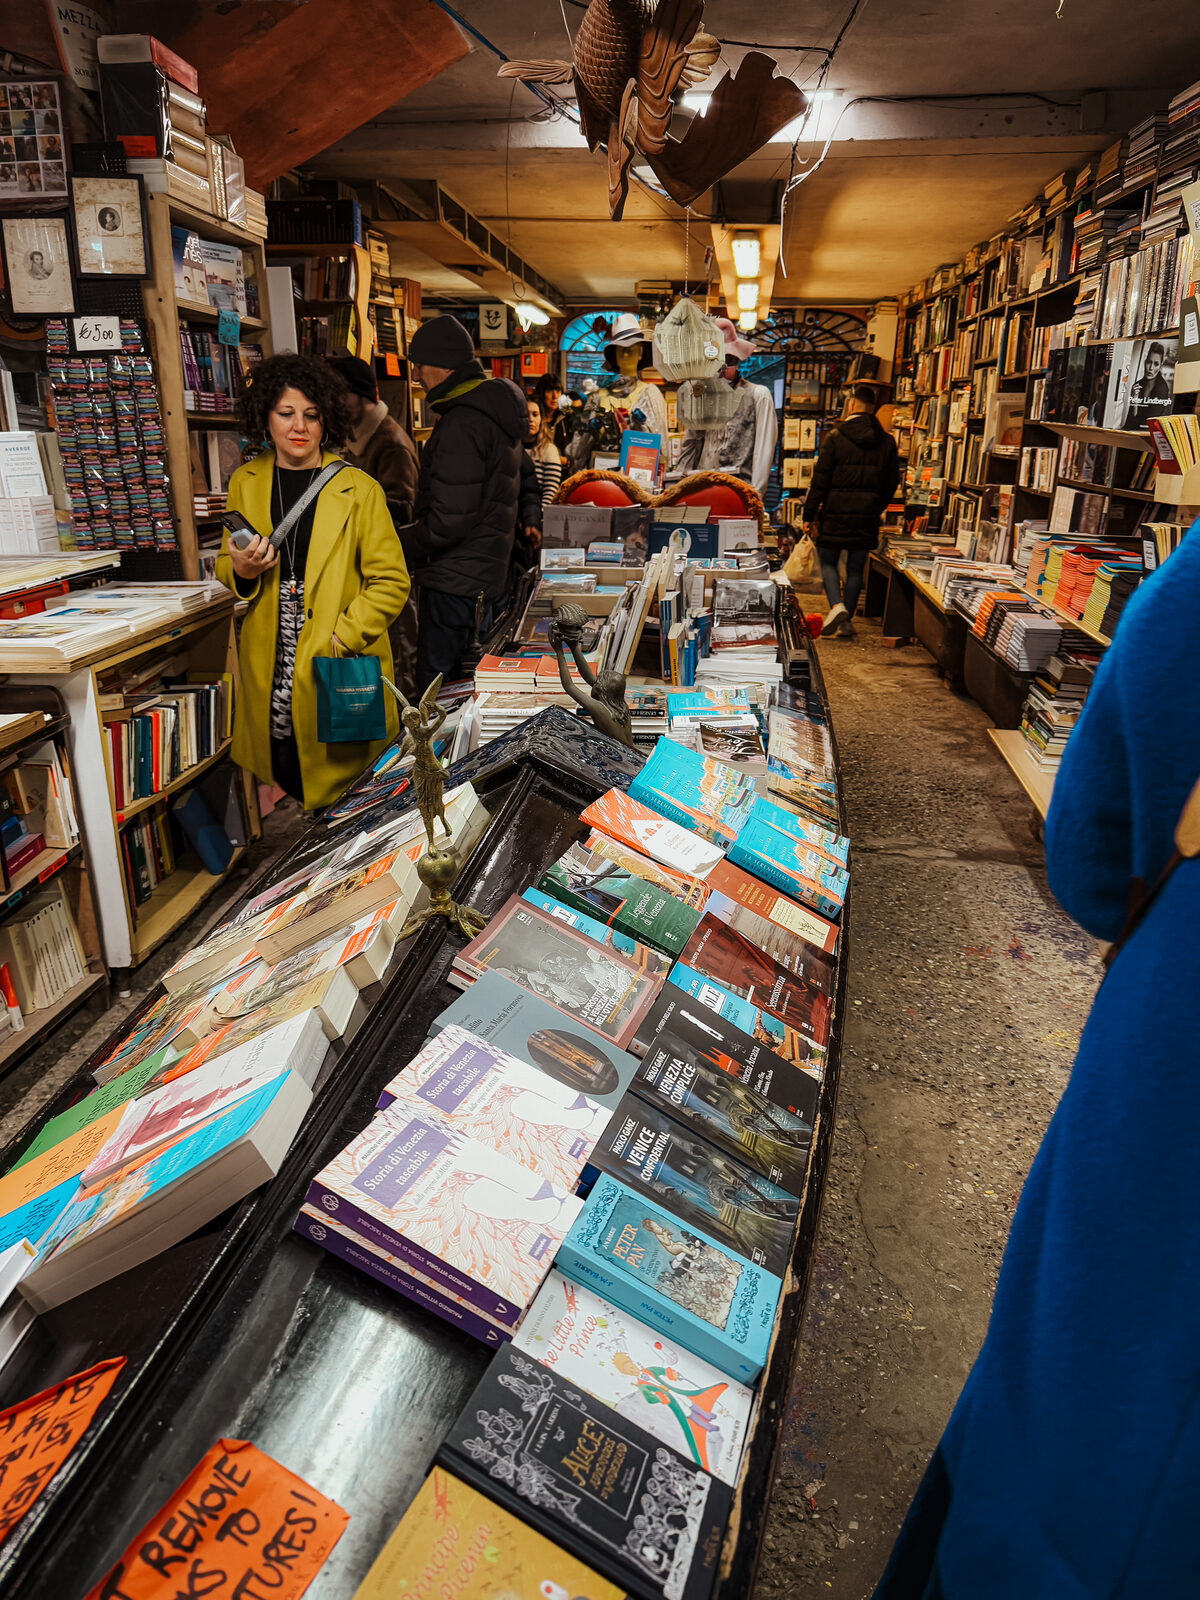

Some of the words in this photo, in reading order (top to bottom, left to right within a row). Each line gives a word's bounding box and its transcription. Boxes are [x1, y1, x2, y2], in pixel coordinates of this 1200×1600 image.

[1128, 396, 1143, 404] Peter
[1143, 396, 1172, 406] Lindbergh
[654, 797, 687, 820] SERENISSIMA
[753, 859, 791, 883] SERENISSIMA
[627, 892, 653, 919] Leggende
[644, 916, 652, 926] di
[649, 898, 667, 921] Venezia
[765, 975, 787, 1010] Serenissima
[479, 1023, 494, 1039] Santa
[490, 1010, 505, 1027] Maria
[502, 993, 525, 1015] Formosa
[580, 1007, 590, 1018] LA
[591, 996, 607, 1019] VENEZIA
[466, 1018, 483, 1033] elitto
[450, 1048, 478, 1077] Venezia
[646, 1065, 659, 1083] PAOLO
[656, 1050, 668, 1068] GANZ
[748, 1045, 761, 1068] Arcana
[446, 1069, 456, 1082] di
[452, 1066, 481, 1097] tascabile
[658, 1058, 685, 1096] VENEZIA
[670, 1062, 697, 1105] COMPLICE
[426, 1076, 450, 1100] Storia
[612, 1136, 625, 1155] PAOLO
[623, 1118, 636, 1138] GANZ
[627, 1126, 656, 1167] VENICE
[363, 1164, 390, 1191] Storia
[389, 1152, 402, 1167] di
[397, 1127, 429, 1158] Venezia
[395, 1148, 431, 1187] tascabile
[640, 1131, 671, 1181] CONFIDENTIAL
[357, 1217, 382, 1238] TASCABILE
[382, 1232, 402, 1249] VENEZIA
[611, 1223, 639, 1261] PETER
[345, 1246, 371, 1266] TASCABILE
[407, 1249, 425, 1263] STORIA
[624, 1245, 646, 1269] PAN
[370, 1260, 392, 1277] VENEZIA
[425, 1260, 450, 1278] VITTORIA
[397, 1276, 416, 1292] STORIA
[448, 1274, 473, 1292] MAURIZIO
[415, 1288, 440, 1305] VITTORIA
[640, 1302, 656, 1315] PAN
[438, 1302, 463, 1320] MAURIZIO
[654, 1311, 674, 1326] PETER
[537, 1349, 558, 1369] he
[555, 1315, 576, 1353] Little
[569, 1314, 598, 1358] Prince
[534, 1430, 547, 1453] LEWIS
[546, 1403, 562, 1433] CARROLL
[589, 1437, 616, 1491] ADVENTURES
[139, 1456, 251, 1578] REMOVE
[215, 1508, 260, 1547] TO
